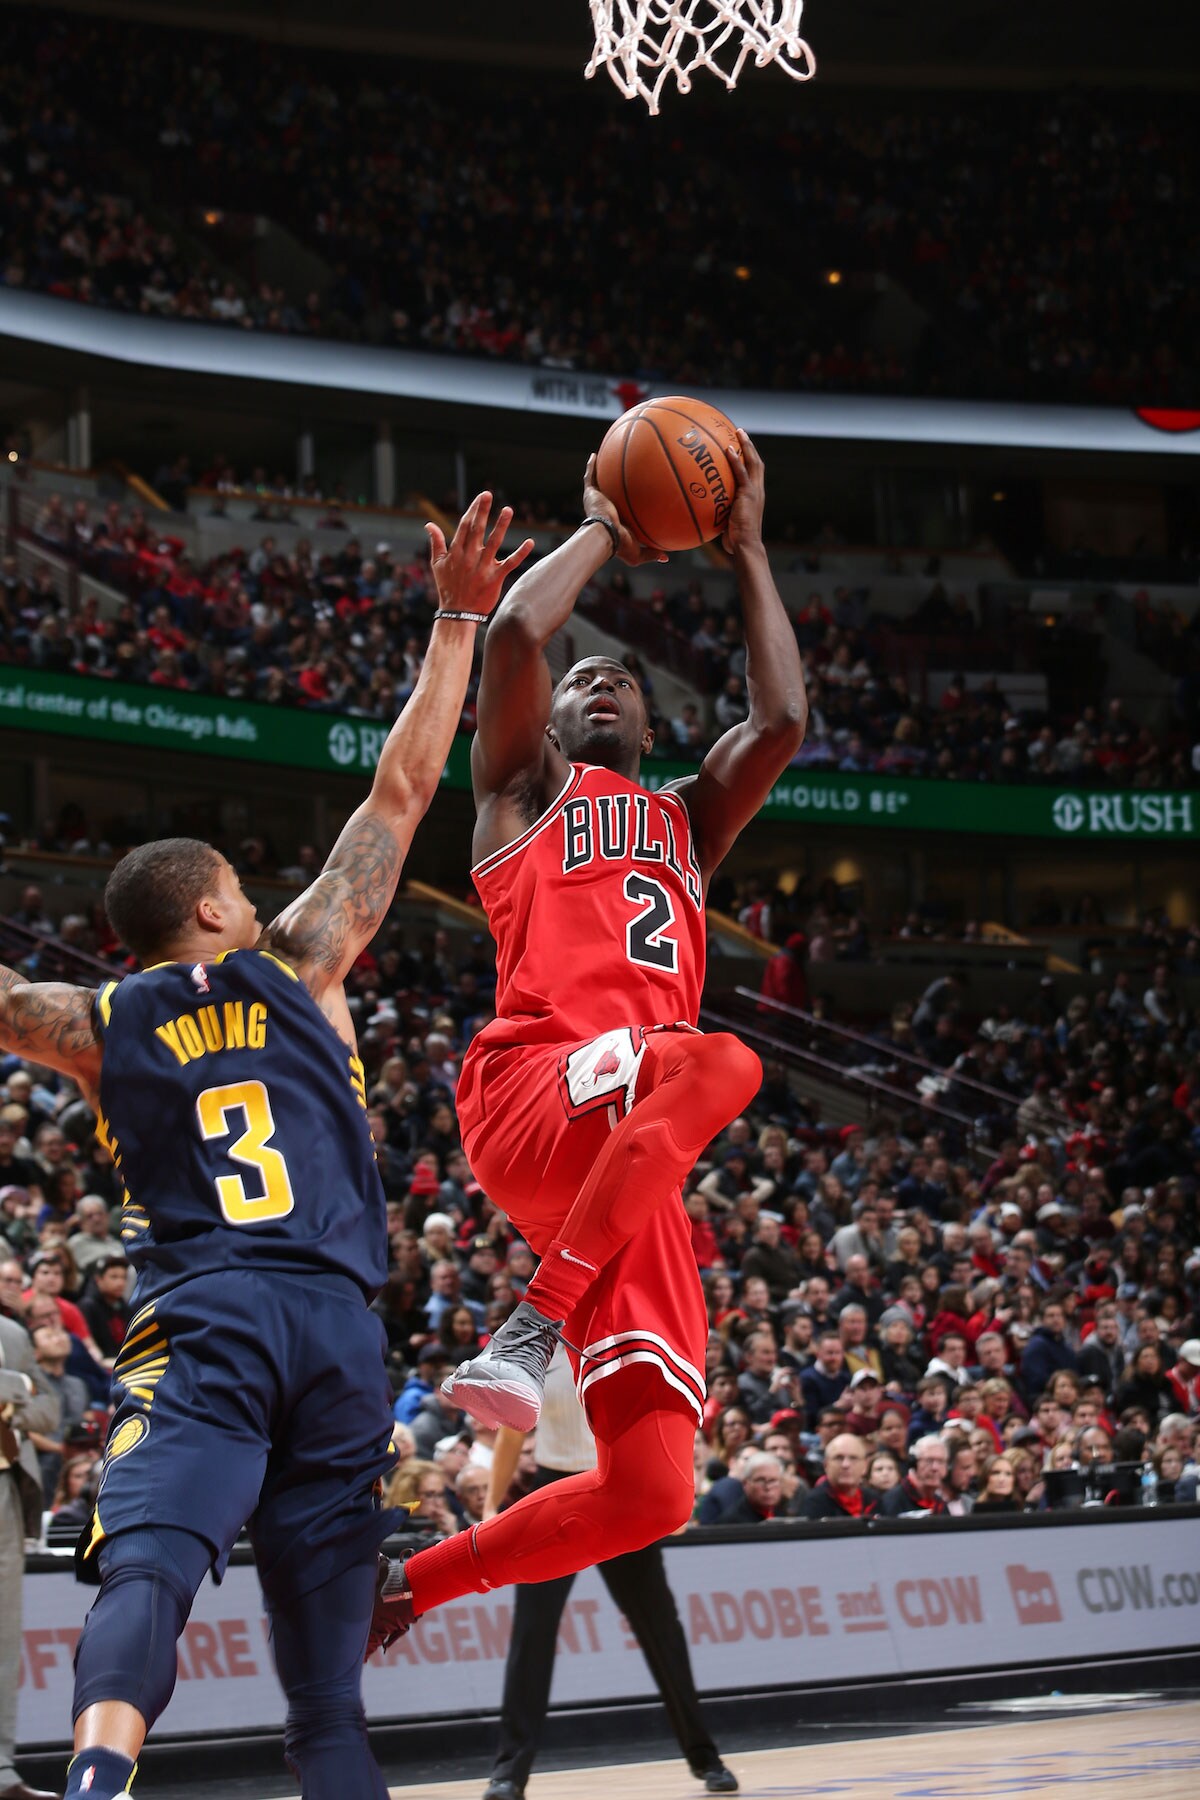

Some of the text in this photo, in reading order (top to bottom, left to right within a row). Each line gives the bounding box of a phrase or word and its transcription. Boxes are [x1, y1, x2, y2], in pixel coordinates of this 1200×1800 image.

[27, 690, 84, 717] center
[87, 696, 110, 720] of
[111, 698, 142, 726] the
[1089, 794, 1194, 833] RUSH
[623, 869, 680, 975] 2
[154, 1000, 268, 1067] YOUNG
[195, 1078, 295, 1226] 3
[687, 1585, 831, 1647] ADOBE
[835, 1581, 886, 1618] and
[894, 1575, 985, 1629] CDW
[1076, 1563, 1200, 1614] CDW.co
